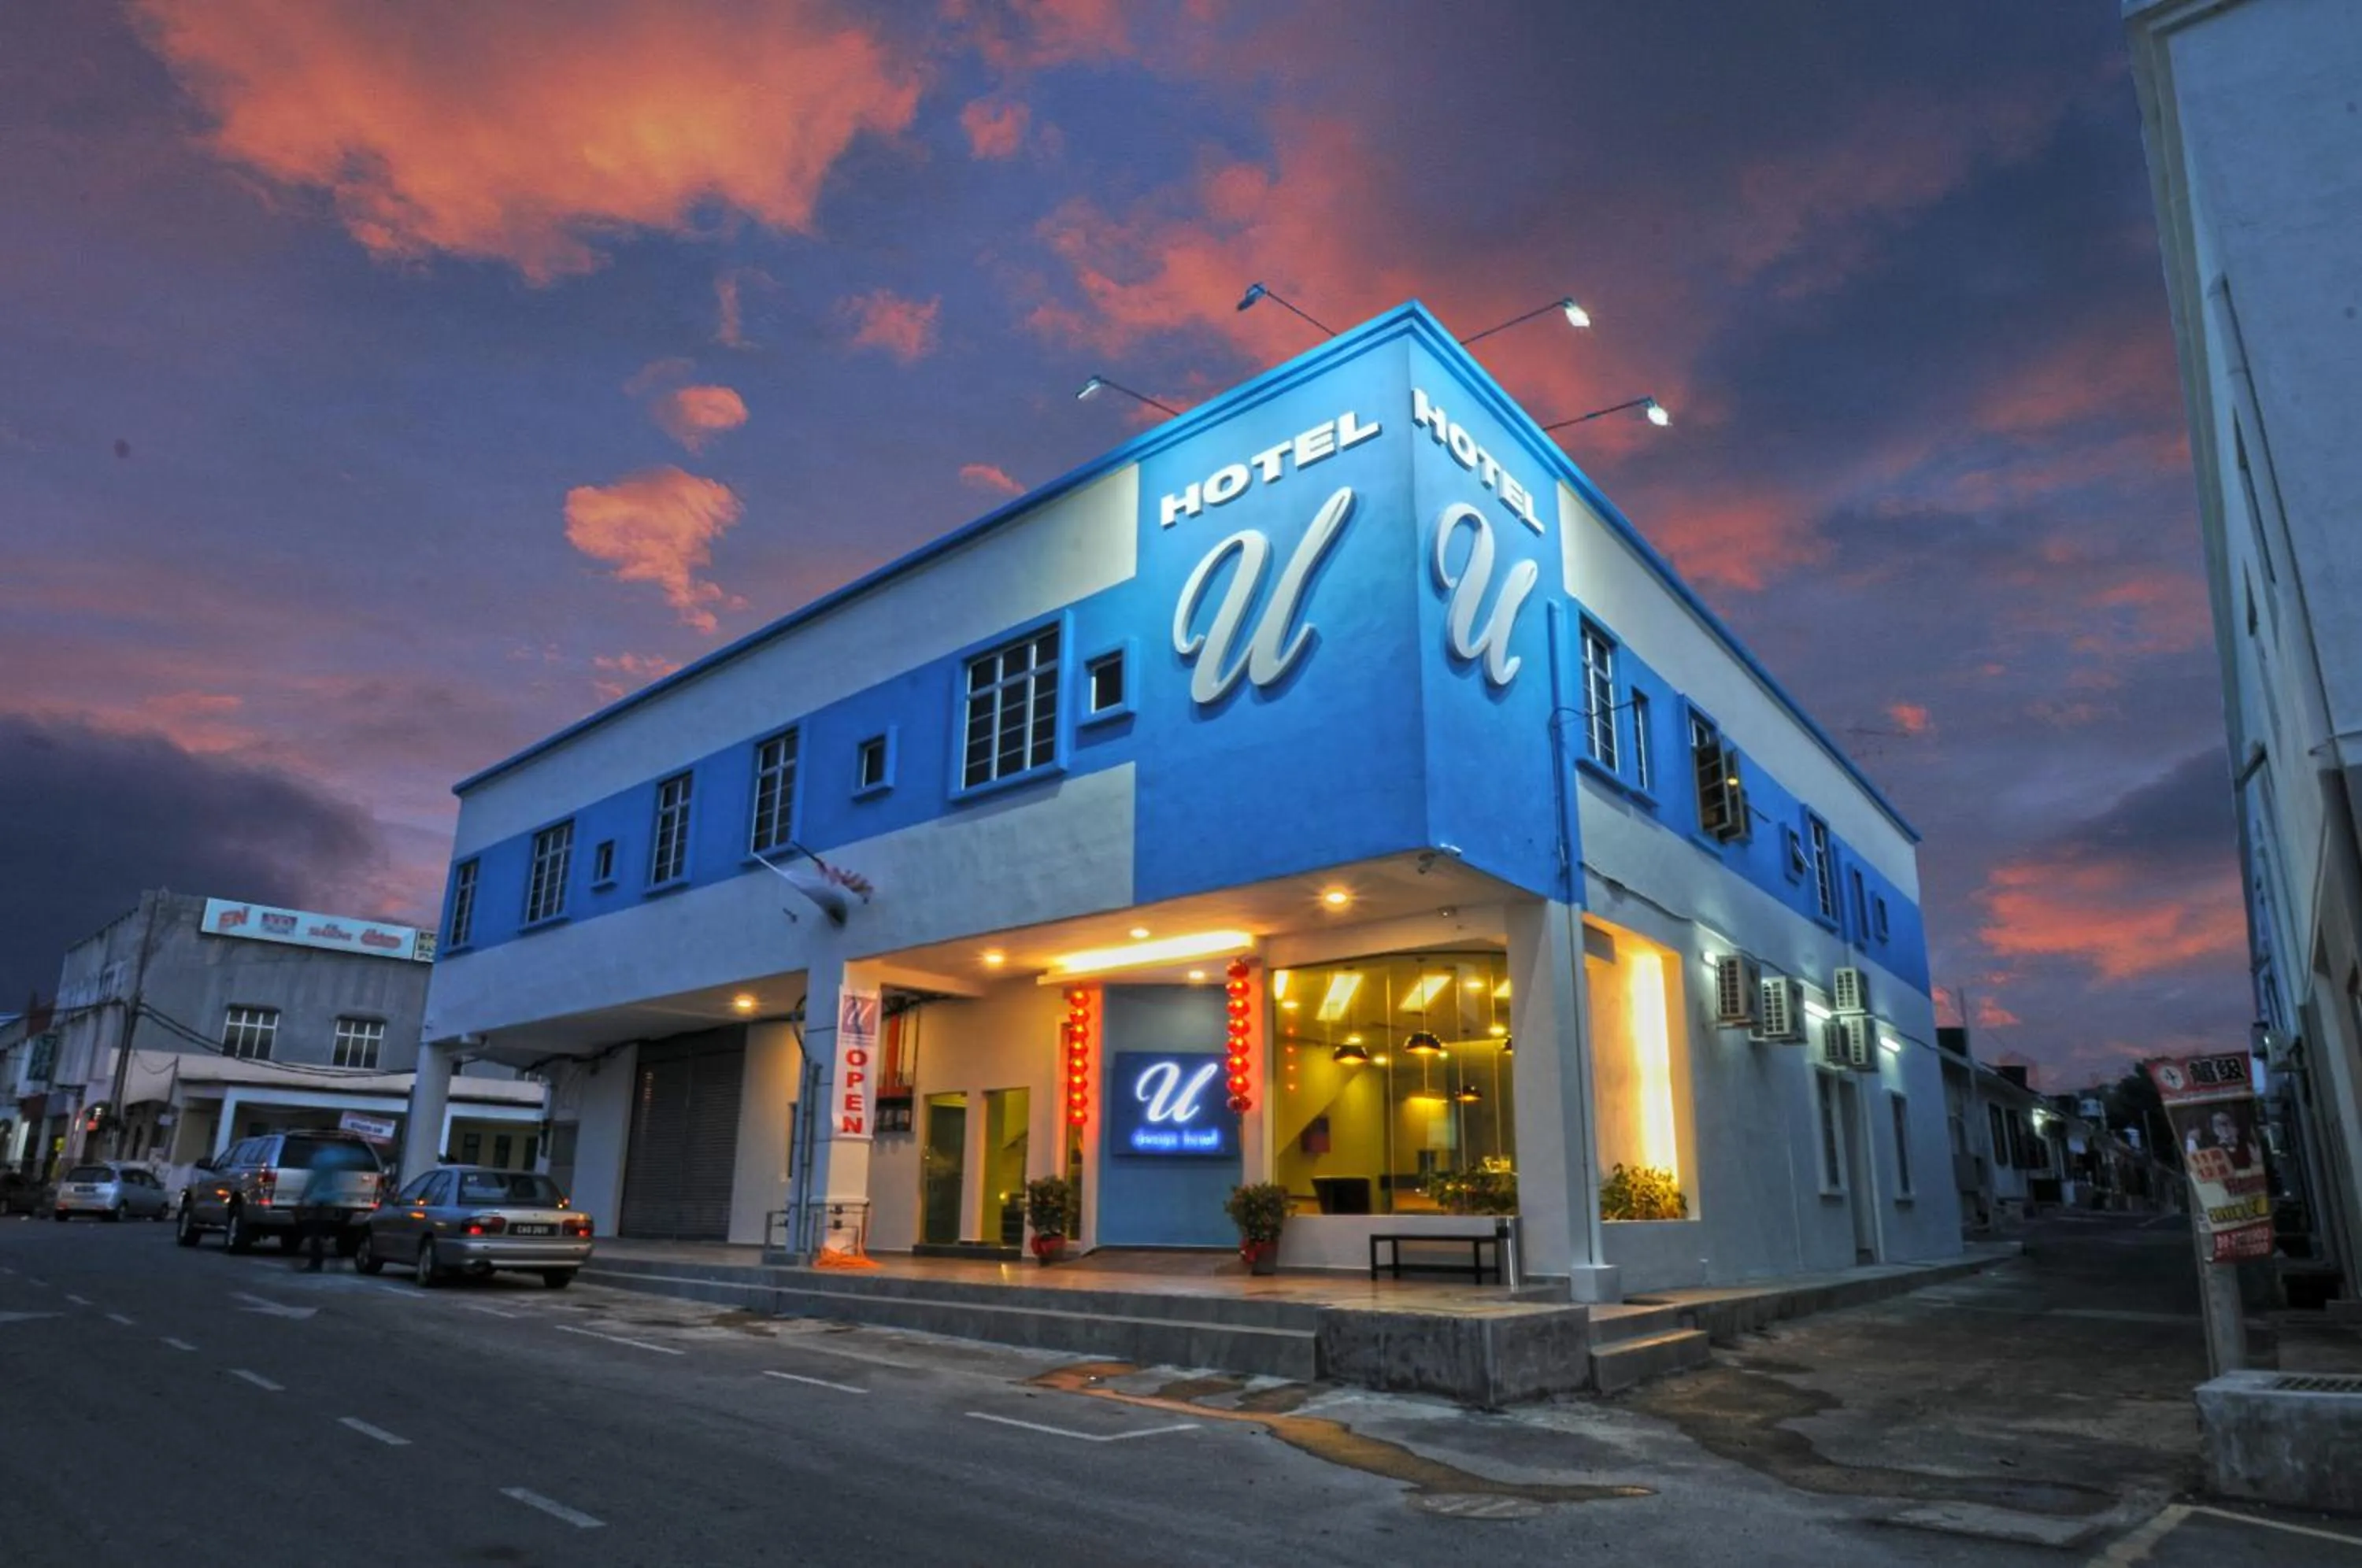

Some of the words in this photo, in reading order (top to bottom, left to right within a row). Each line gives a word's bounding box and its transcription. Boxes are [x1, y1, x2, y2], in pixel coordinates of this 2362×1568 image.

[1160, 411, 1382, 531] HOTEL
[1412, 387, 1545, 536] HOTEL
[1173, 486, 1353, 703] U
[1435, 502, 1538, 686] U
[842, 1048, 868, 1134] OPEN
[1135, 1062, 1219, 1122] U
